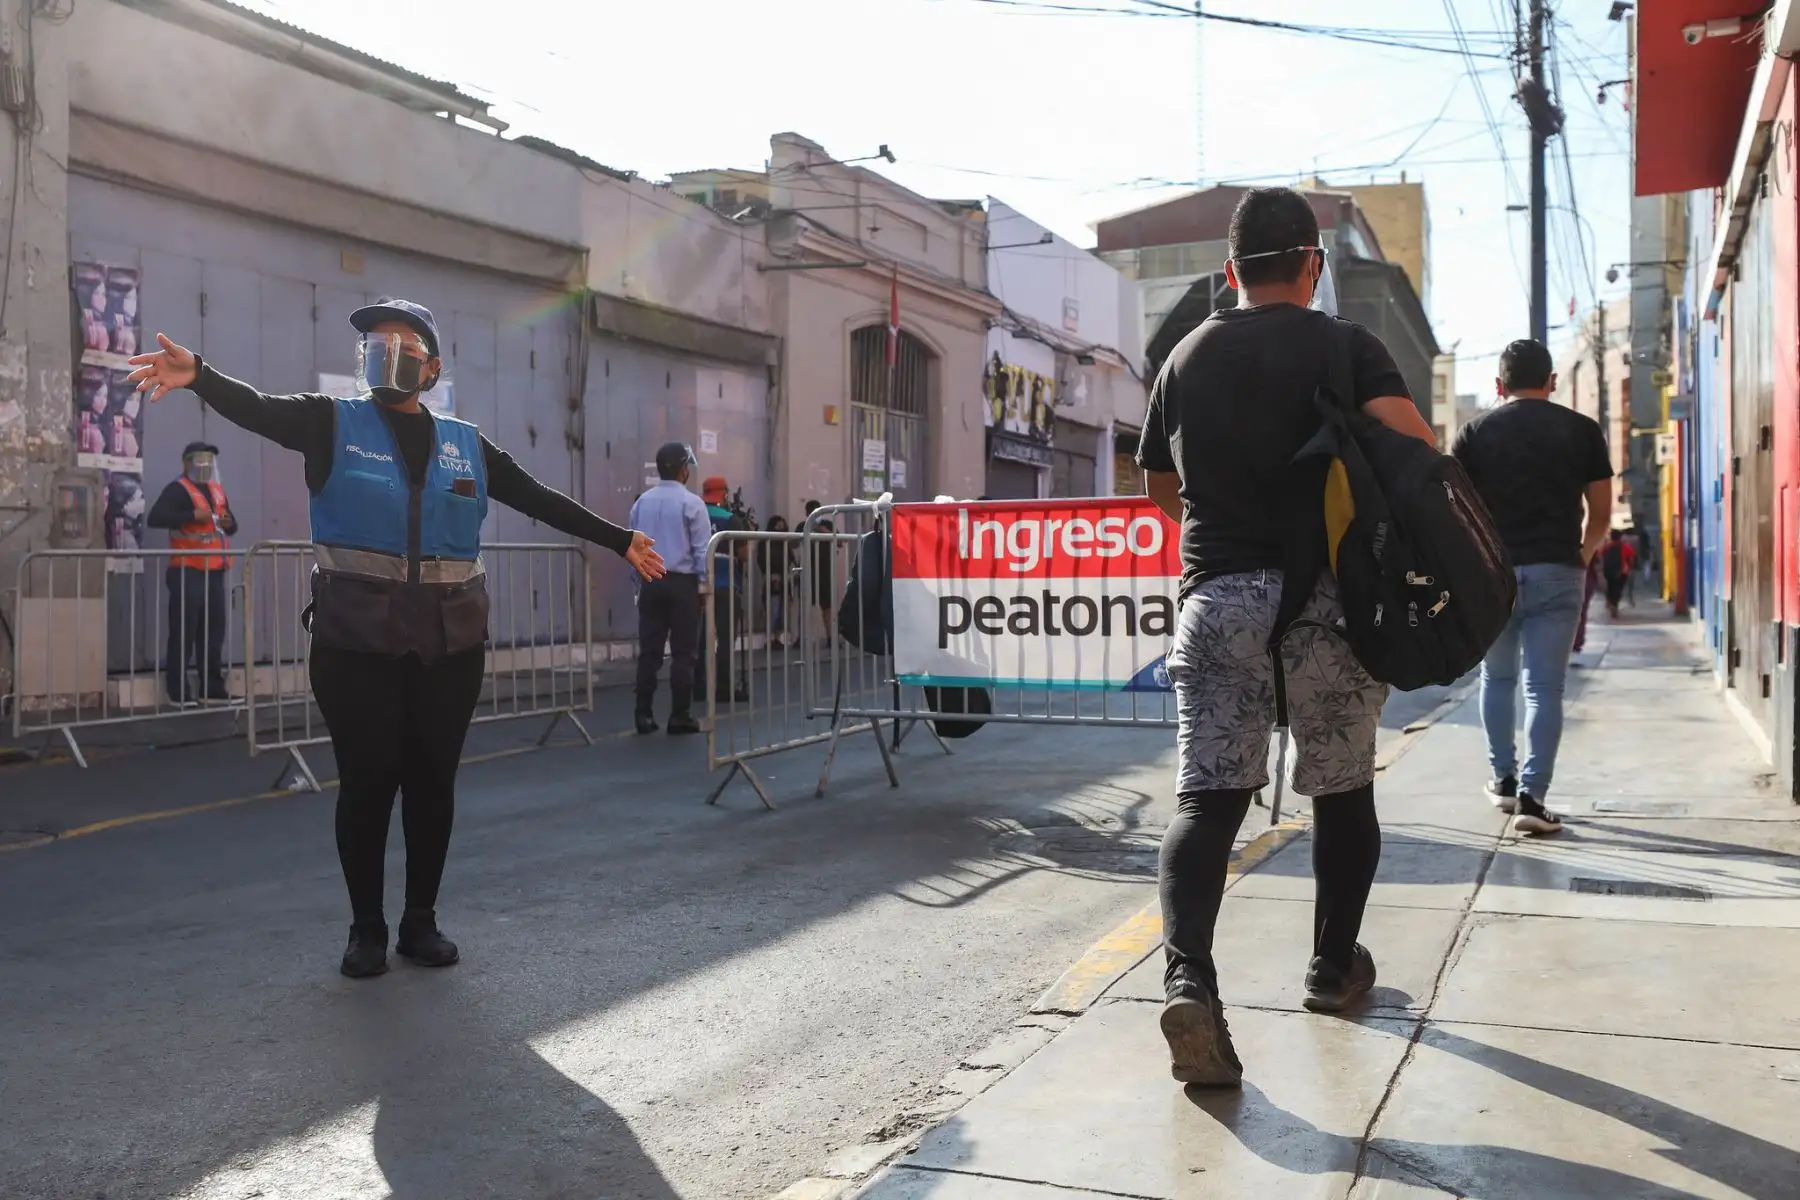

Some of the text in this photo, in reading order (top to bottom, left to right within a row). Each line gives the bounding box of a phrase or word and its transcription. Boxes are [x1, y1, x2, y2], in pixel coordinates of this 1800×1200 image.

[440, 459, 473, 475] LIMA
[957, 507, 1163, 572] Ingreso
[938, 589, 1175, 649] peatona
